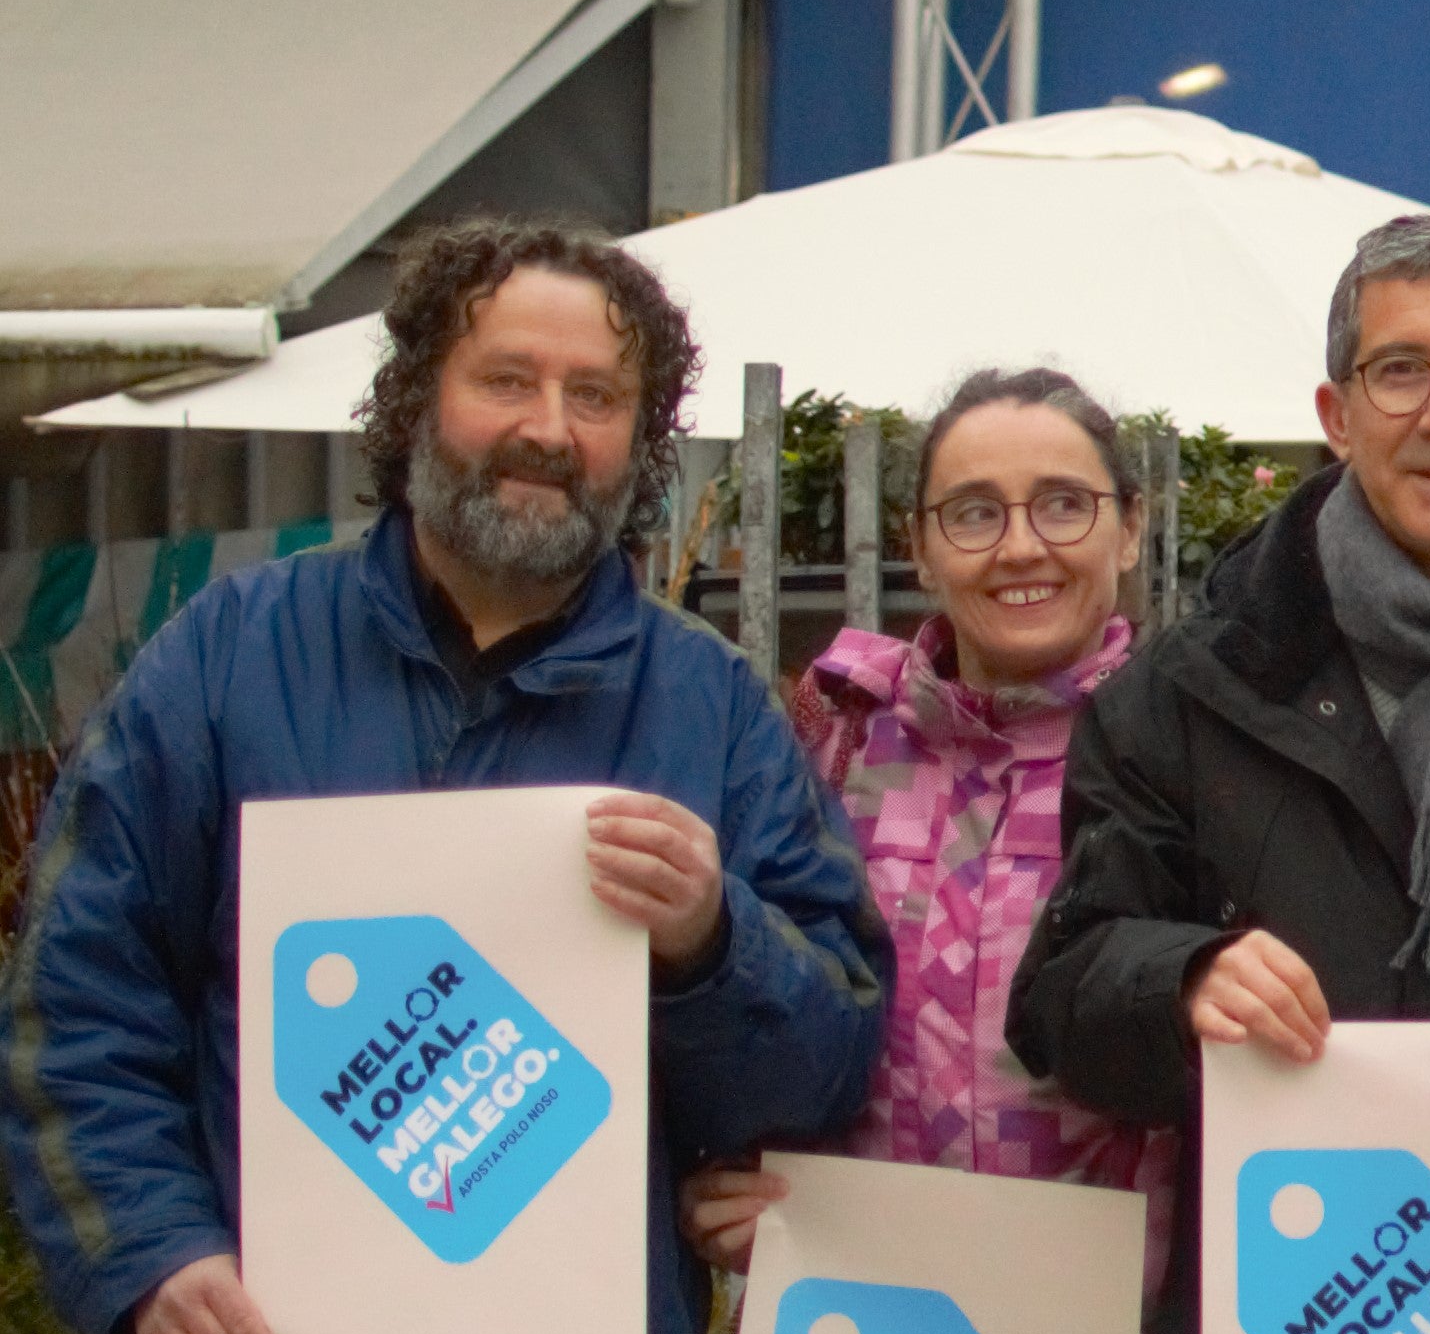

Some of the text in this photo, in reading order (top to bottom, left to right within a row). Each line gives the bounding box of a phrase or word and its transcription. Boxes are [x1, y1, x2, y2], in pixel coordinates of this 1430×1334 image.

[320, 962, 465, 1117] MELLOR
[348, 1018, 478, 1145] LOCAL.
[376, 1018, 524, 1175] MELLOR
[458, 1087, 559, 1198] APOSTA POLO NOSO
